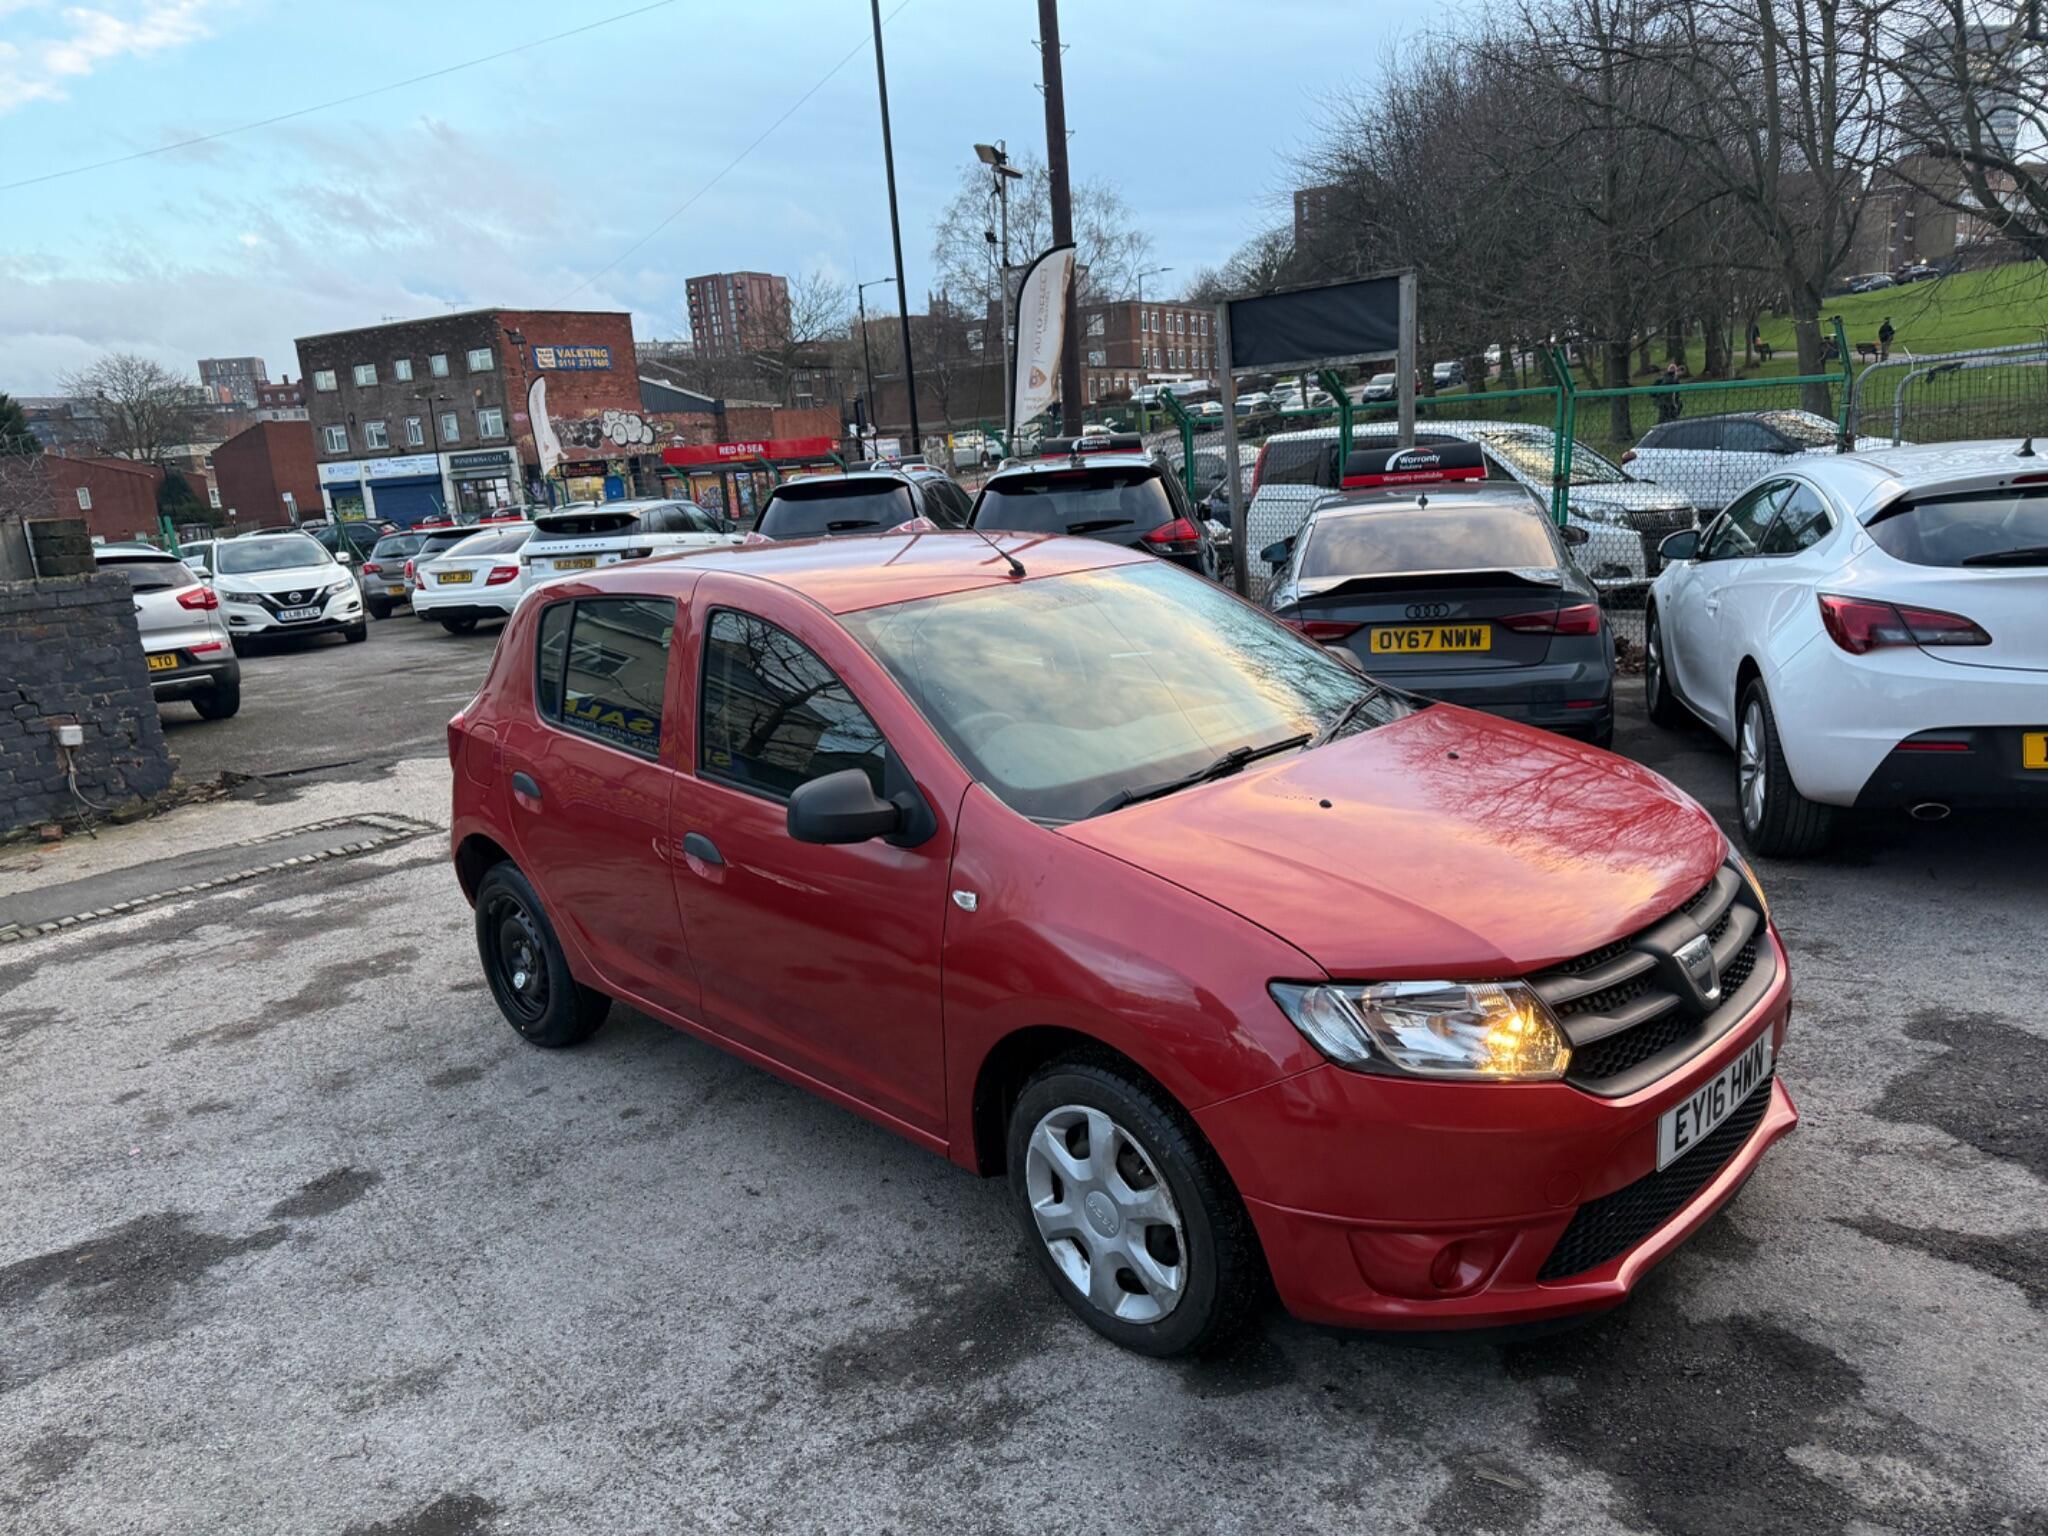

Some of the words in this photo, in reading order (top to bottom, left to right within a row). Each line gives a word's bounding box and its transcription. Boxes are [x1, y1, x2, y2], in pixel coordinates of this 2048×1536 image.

[1033, 317, 1043, 355] AUTO
[1038, 266, 1049, 314] SELECT
[556, 348, 609, 358] VALETING
[719, 445, 737, 455] RED
[747, 443, 764, 453] SEA
[1399, 454, 1441, 465] Warranty
[1382, 473, 1412, 482] Warranty
[1413, 471, 1444, 480] available
[1379, 630, 1434, 650] OY67
[1440, 628, 1482, 648] NWW
[1674, 1076, 1726, 1152] EY16
[1731, 1036, 1764, 1106] HWN
